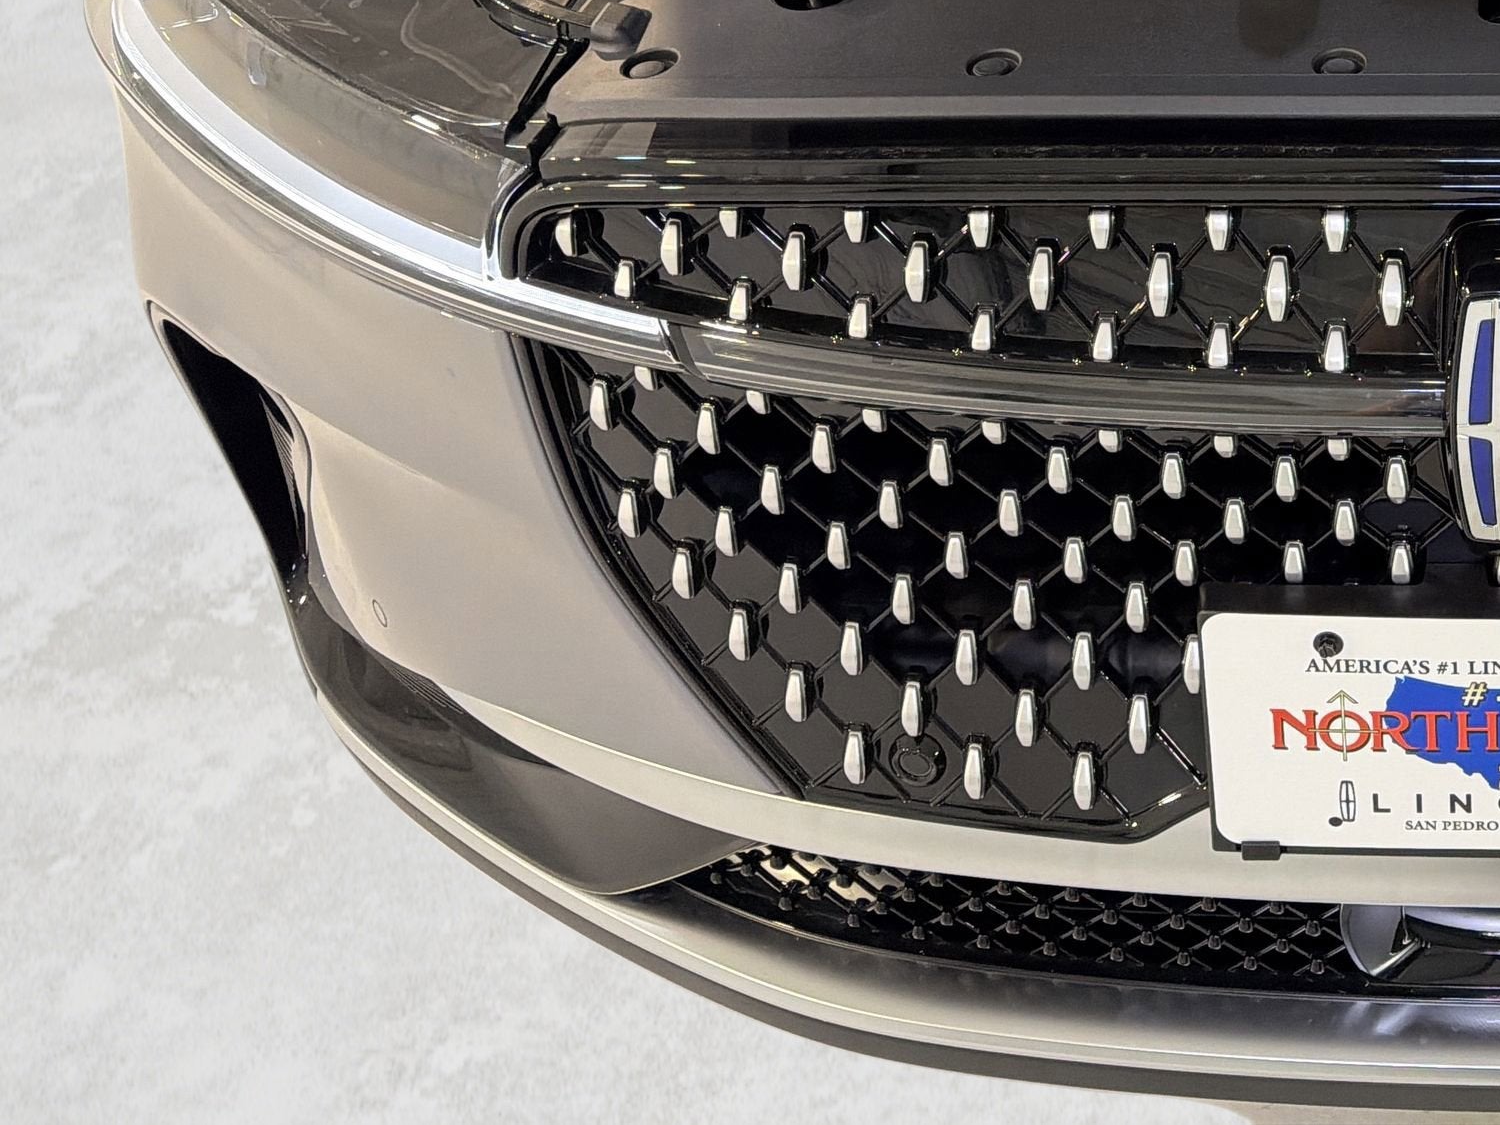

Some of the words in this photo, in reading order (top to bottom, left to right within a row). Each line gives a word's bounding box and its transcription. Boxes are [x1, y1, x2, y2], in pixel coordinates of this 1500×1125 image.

[1305, 658, 1431, 675] AMERICA'S
[1436, 660, 1460, 675] #1
[1270, 708, 1500, 753] NORTH
[1405, 820, 1437, 831] SAN
[1442, 820, 1499, 831] PEDRO
